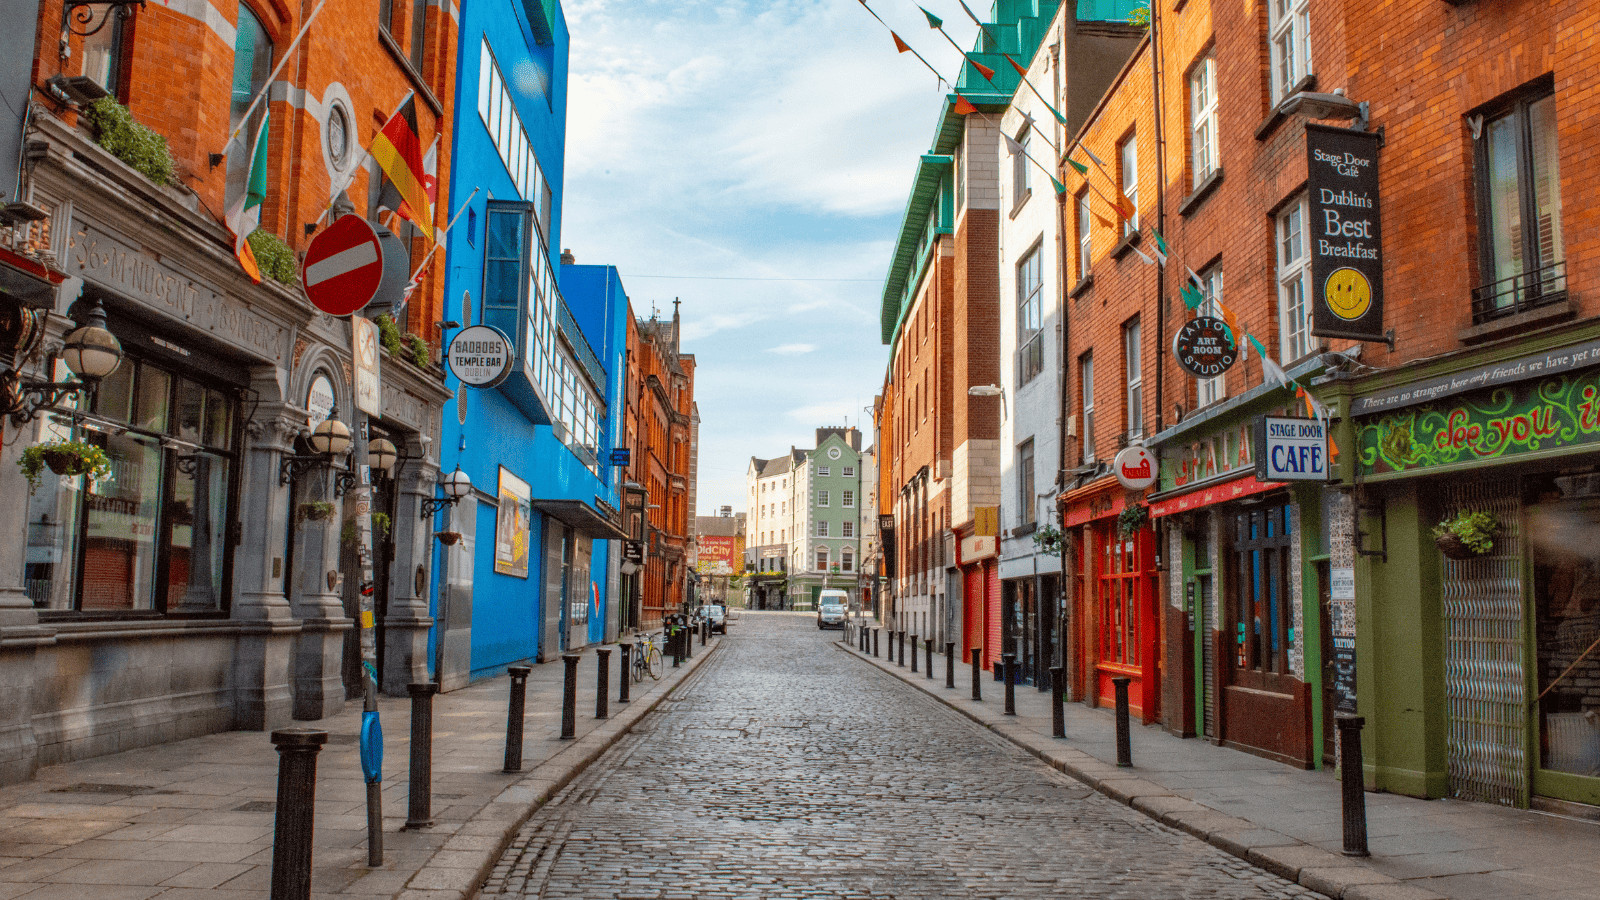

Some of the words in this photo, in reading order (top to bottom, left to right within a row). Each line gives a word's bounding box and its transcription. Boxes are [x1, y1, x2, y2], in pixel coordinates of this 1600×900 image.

[1314, 149, 1343, 167] Stage
[1344, 153, 1370, 168] Door
[1337, 164, 1359, 177] Café
[1320, 188, 1372, 208] Dublin's
[1324, 209, 1372, 238] Best
[1319, 239, 1377, 260] Breakfast
[455, 340, 502, 354] BADBOBS
[1197, 337, 1218, 346] ART
[1193, 346, 1222, 355] ROOM
[455, 356, 485, 367] TEMPLE
[486, 357, 501, 367] BAR
[1184, 355, 1232, 374] STUDIO
[464, 367, 491, 377] DUBLIN
[1362, 397, 1385, 409] There
[1386, 395, 1399, 404] are
[1401, 392, 1411, 402] no
[1412, 382, 1449, 399] strangers
[1450, 376, 1468, 390] here
[1469, 370, 1491, 388] only
[1491, 363, 1526, 380] friends
[1529, 360, 1543, 371] we
[1545, 355, 1568, 369] have
[1570, 350, 1589, 367] yet
[1269, 423, 1296, 437] STAGE
[1298, 424, 1323, 438] DOOR
[1474, 404, 1560, 457] you
[1271, 443, 1323, 473] CAFÉ
[1334, 638, 1355, 648] TATTOO
